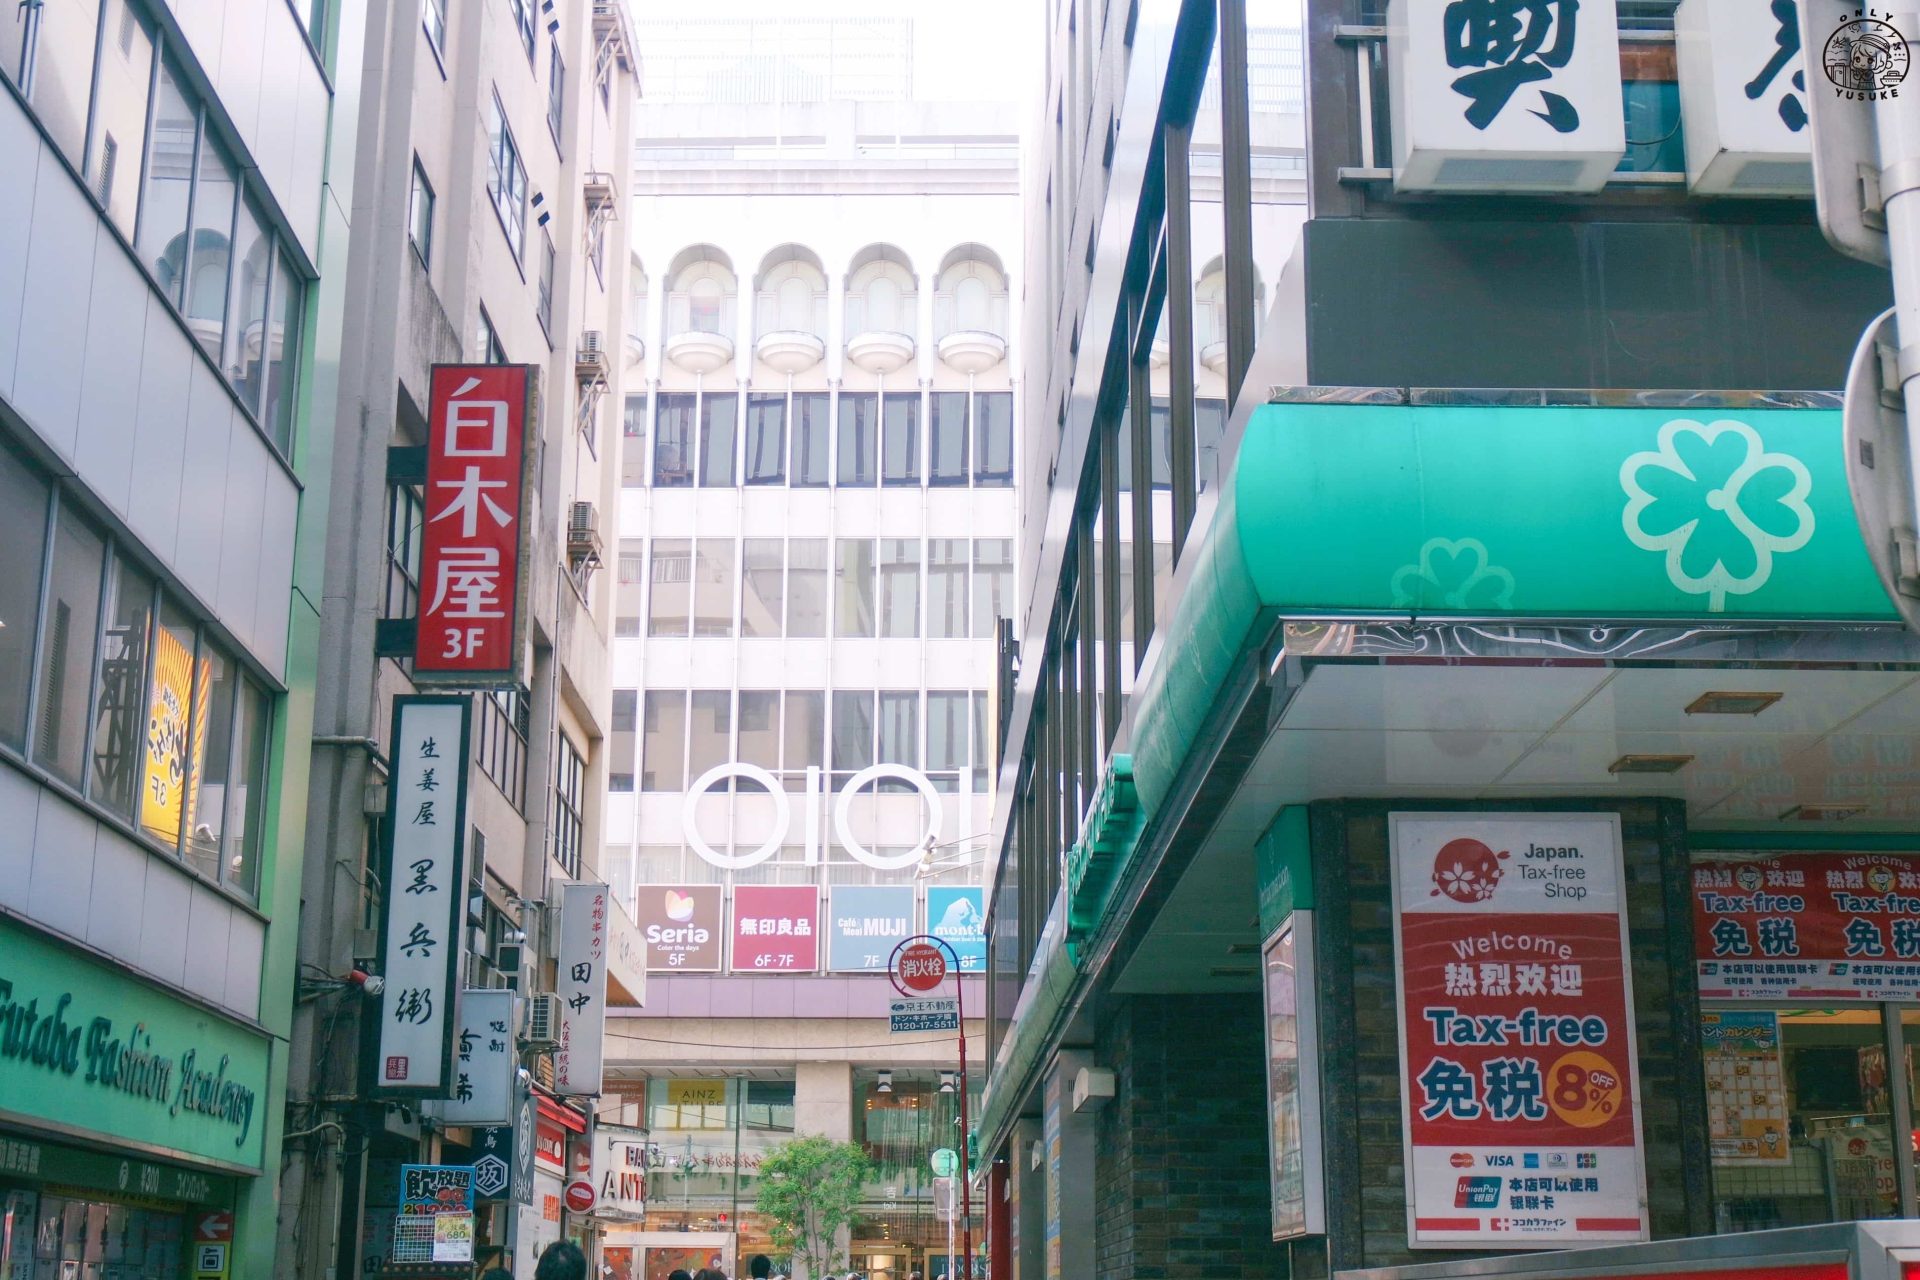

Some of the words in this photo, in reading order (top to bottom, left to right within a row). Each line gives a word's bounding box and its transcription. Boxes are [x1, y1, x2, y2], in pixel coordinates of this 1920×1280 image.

[426, 376, 514, 623] 白木屋
[442, 628, 485, 658] 3F
[411, 735, 441, 826] 生姜屋
[1523, 843, 1585, 862] Japan.
[1843, 854, 1913, 871] Welcome
[1517, 864, 1587, 880] Tax-free
[1544, 882, 1588, 901] Shop
[1699, 891, 1806, 913] Tax-free
[590, 895, 604, 961] 名物串カツ
[646, 923, 710, 944] Seria
[740, 917, 812, 937] 無印良品
[863, 917, 907, 937] MUJI
[1711, 917, 1800, 957] 免税
[1452, 931, 1573, 961] Welcome
[668, 953, 686, 967] 5F
[863, 954, 881, 968] 7F
[902, 957, 943, 979] 消火栓
[960, 955, 978, 968] 8F
[1722, 963, 1819, 976] 本店可以使用银联卡
[1444, 962, 1584, 997] 热烈欢迎
[1851, 964, 1920, 977] 本店可以使用
[568, 961, 593, 1017] 田中
[905, 1000, 956, 1013] 京王不動産
[891, 1020, 957, 1032] 0120-17-5511
[1424, 1008, 1607, 1046] Tax-free
[85, 1016, 173, 1104] Fashion
[170, 1048, 255, 1147] Academy
[1416, 1056, 1548, 1122] 免税
[1590, 1071, 1615, 1089] OFF
[682, 1089, 716, 1100] AINZ
[625, 1146, 648, 1169] BA
[1485, 1154, 1515, 1167] VISA
[1576, 1153, 1597, 1168] JCB
[478, 1163, 500, 1188] 坂
[1509, 1177, 1599, 1193] 本店可以使用
[600, 1170, 647, 1204] ANT
[1458, 1183, 1499, 1197] UnionPay
[1509, 1195, 1555, 1211] 银联卡
[1512, 1217, 1567, 1228] ココカラファイン
